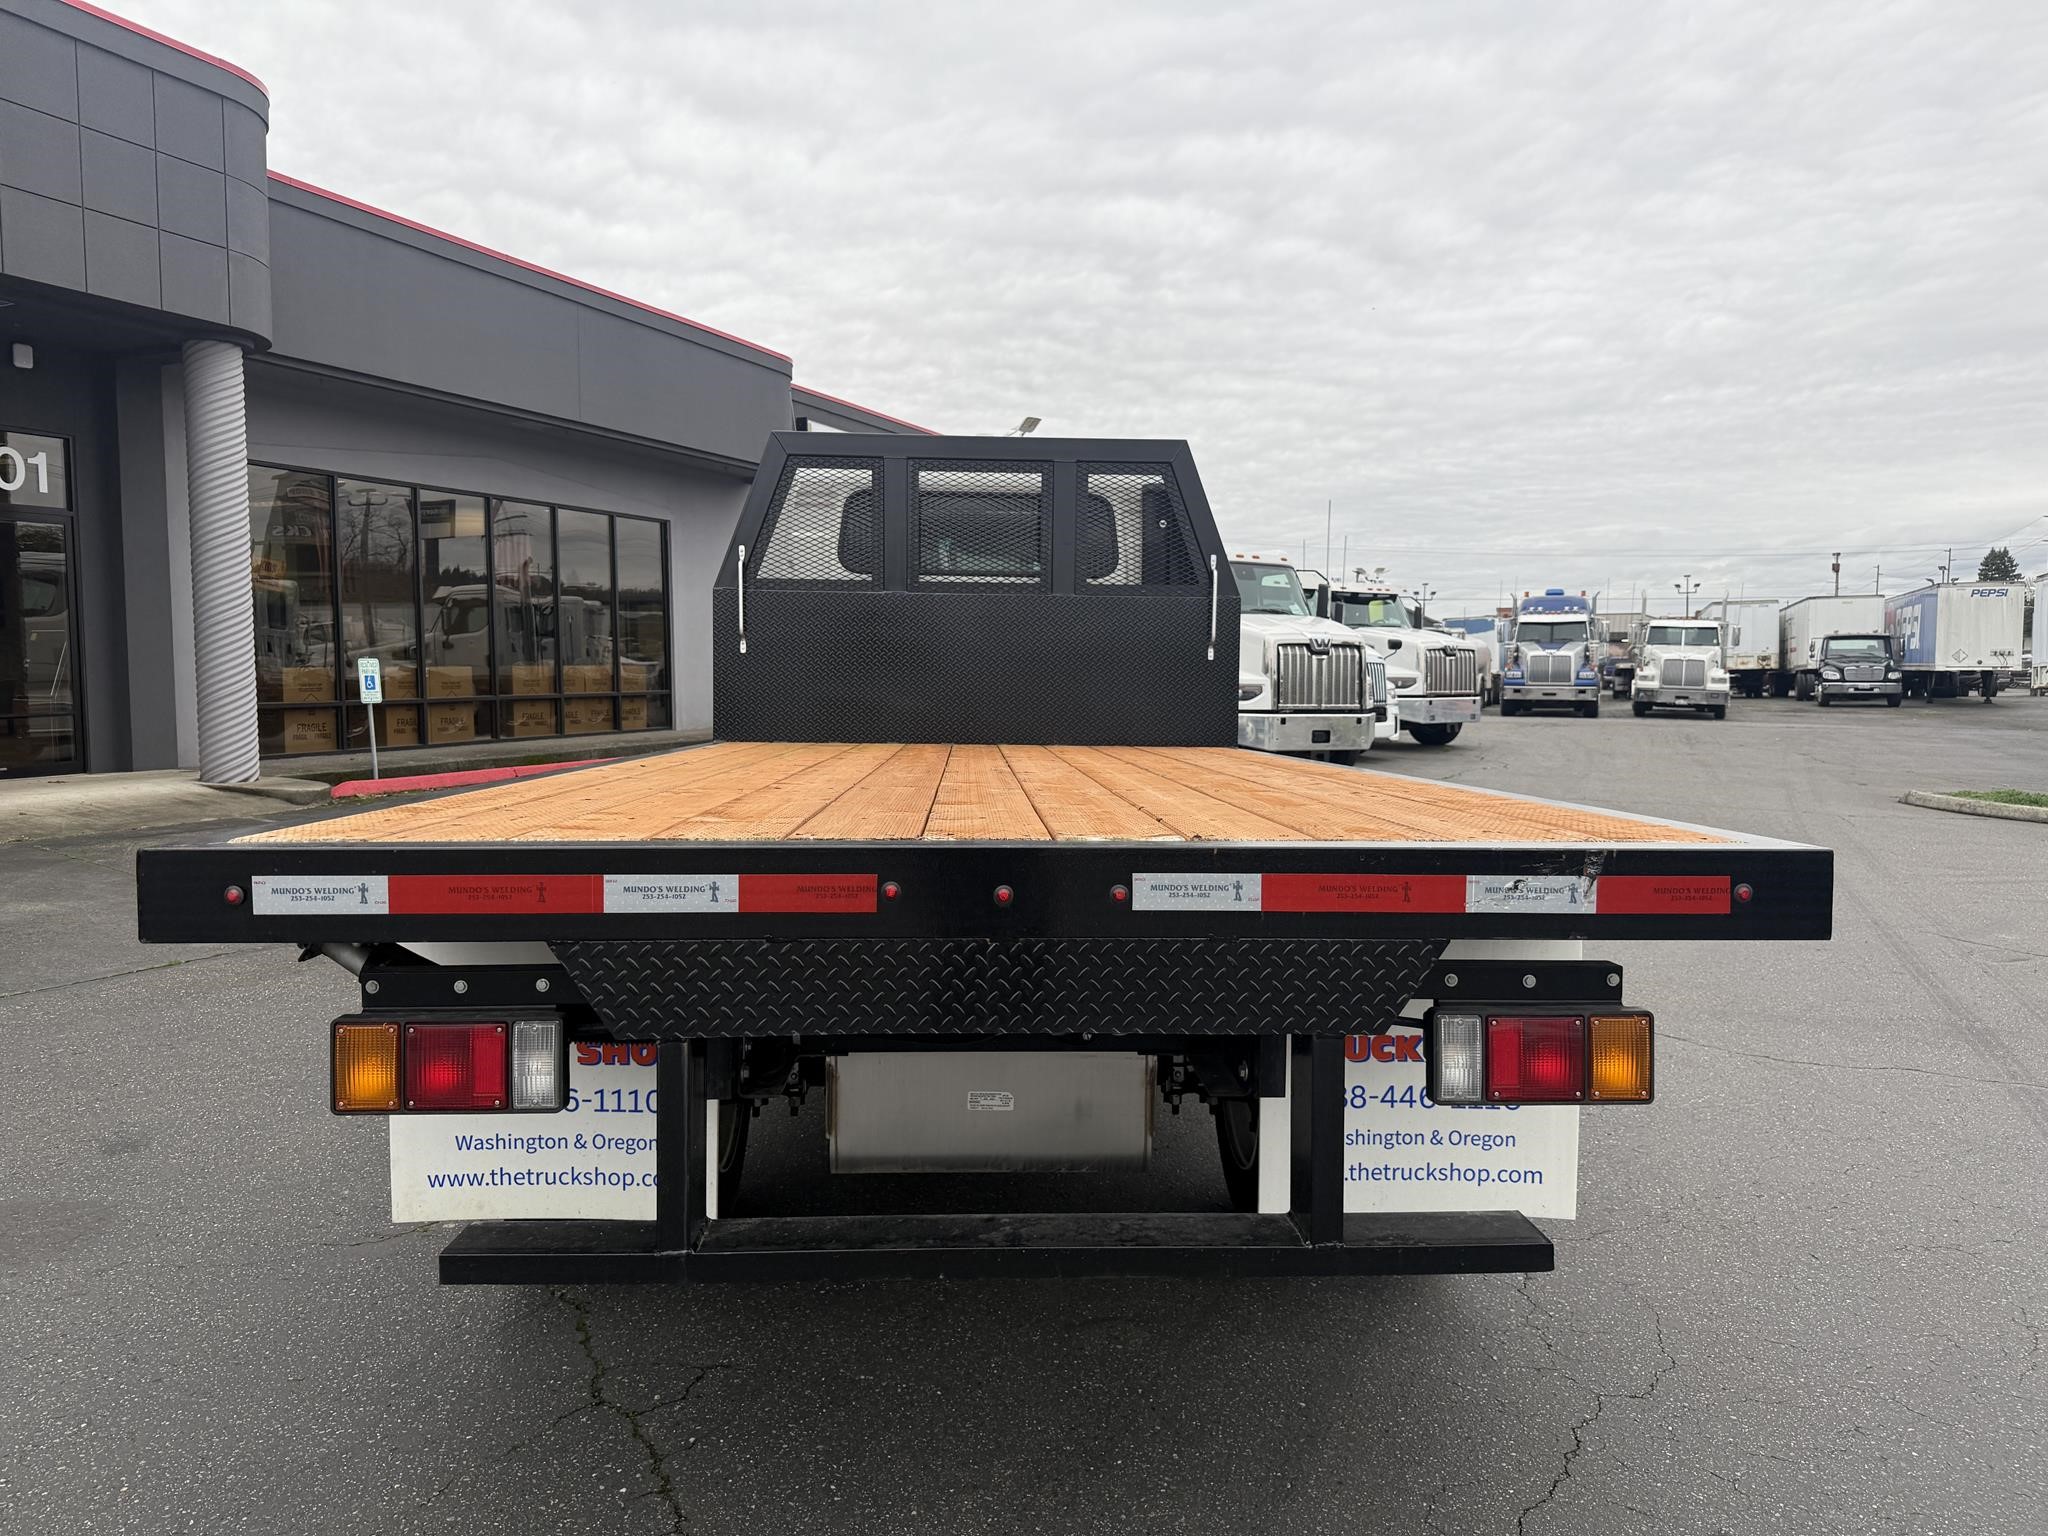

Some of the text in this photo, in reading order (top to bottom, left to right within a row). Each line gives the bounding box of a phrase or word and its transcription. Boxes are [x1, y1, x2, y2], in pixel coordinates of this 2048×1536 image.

[1971, 588, 2009, 598] PEPSI
[297, 722, 327, 733] FRAGILE
[271, 887, 312, 895] MUNDO'S
[448, 886, 490, 894] MUNDO'S
[623, 885, 706, 893] MUNDO'S WELDING
[797, 885, 836, 893] MUNDO'S
[1150, 884, 1189, 892] MUNDO'S
[1318, 885, 1357, 893] MUNDO'S
[455, 1133, 568, 1154] Washington
[573, 1133, 587, 1150] &
[1430, 1130, 1443, 1145] &
[1449, 1130, 1516, 1151] Oregon
